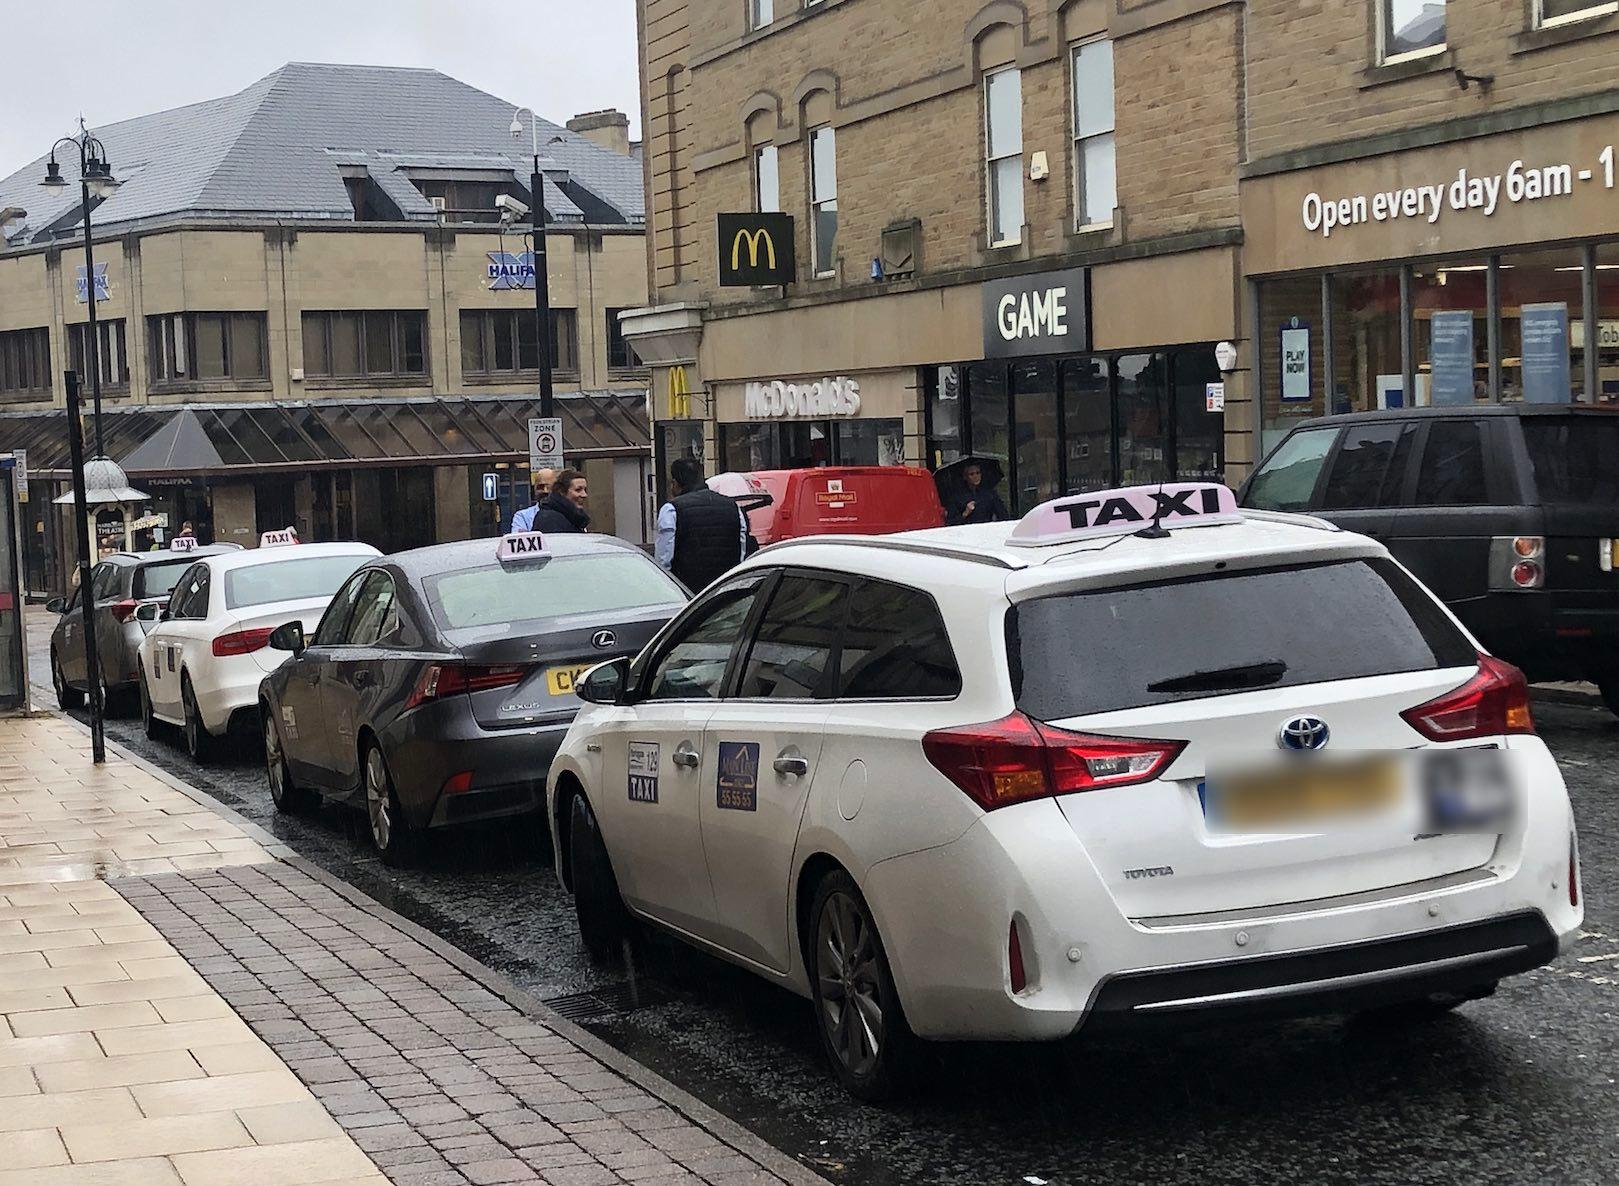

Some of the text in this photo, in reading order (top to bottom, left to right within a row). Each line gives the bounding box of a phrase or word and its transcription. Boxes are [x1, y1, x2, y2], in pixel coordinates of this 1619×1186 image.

[1302, 192, 1367, 237] Open
[1372, 183, 1444, 223] every
[1449, 168, 1501, 216] day
[1506, 159, 1573, 203] 6am
[489, 265, 535, 277] HALIFA
[997, 286, 1068, 341] GAME
[1286, 350, 1305, 362] PLAY
[1286, 362, 1305, 374] NOW
[745, 376, 861, 418] McDonald's
[1054, 488, 1221, 529] TAXI
[174, 538, 195, 549] TAXI
[265, 533, 289, 544] TAXI
[508, 536, 543, 553] TAXI
[501, 702, 540, 712] LEXUS
[630, 777, 655, 801] TAXI
[1123, 866, 1174, 879] TOYOTA
